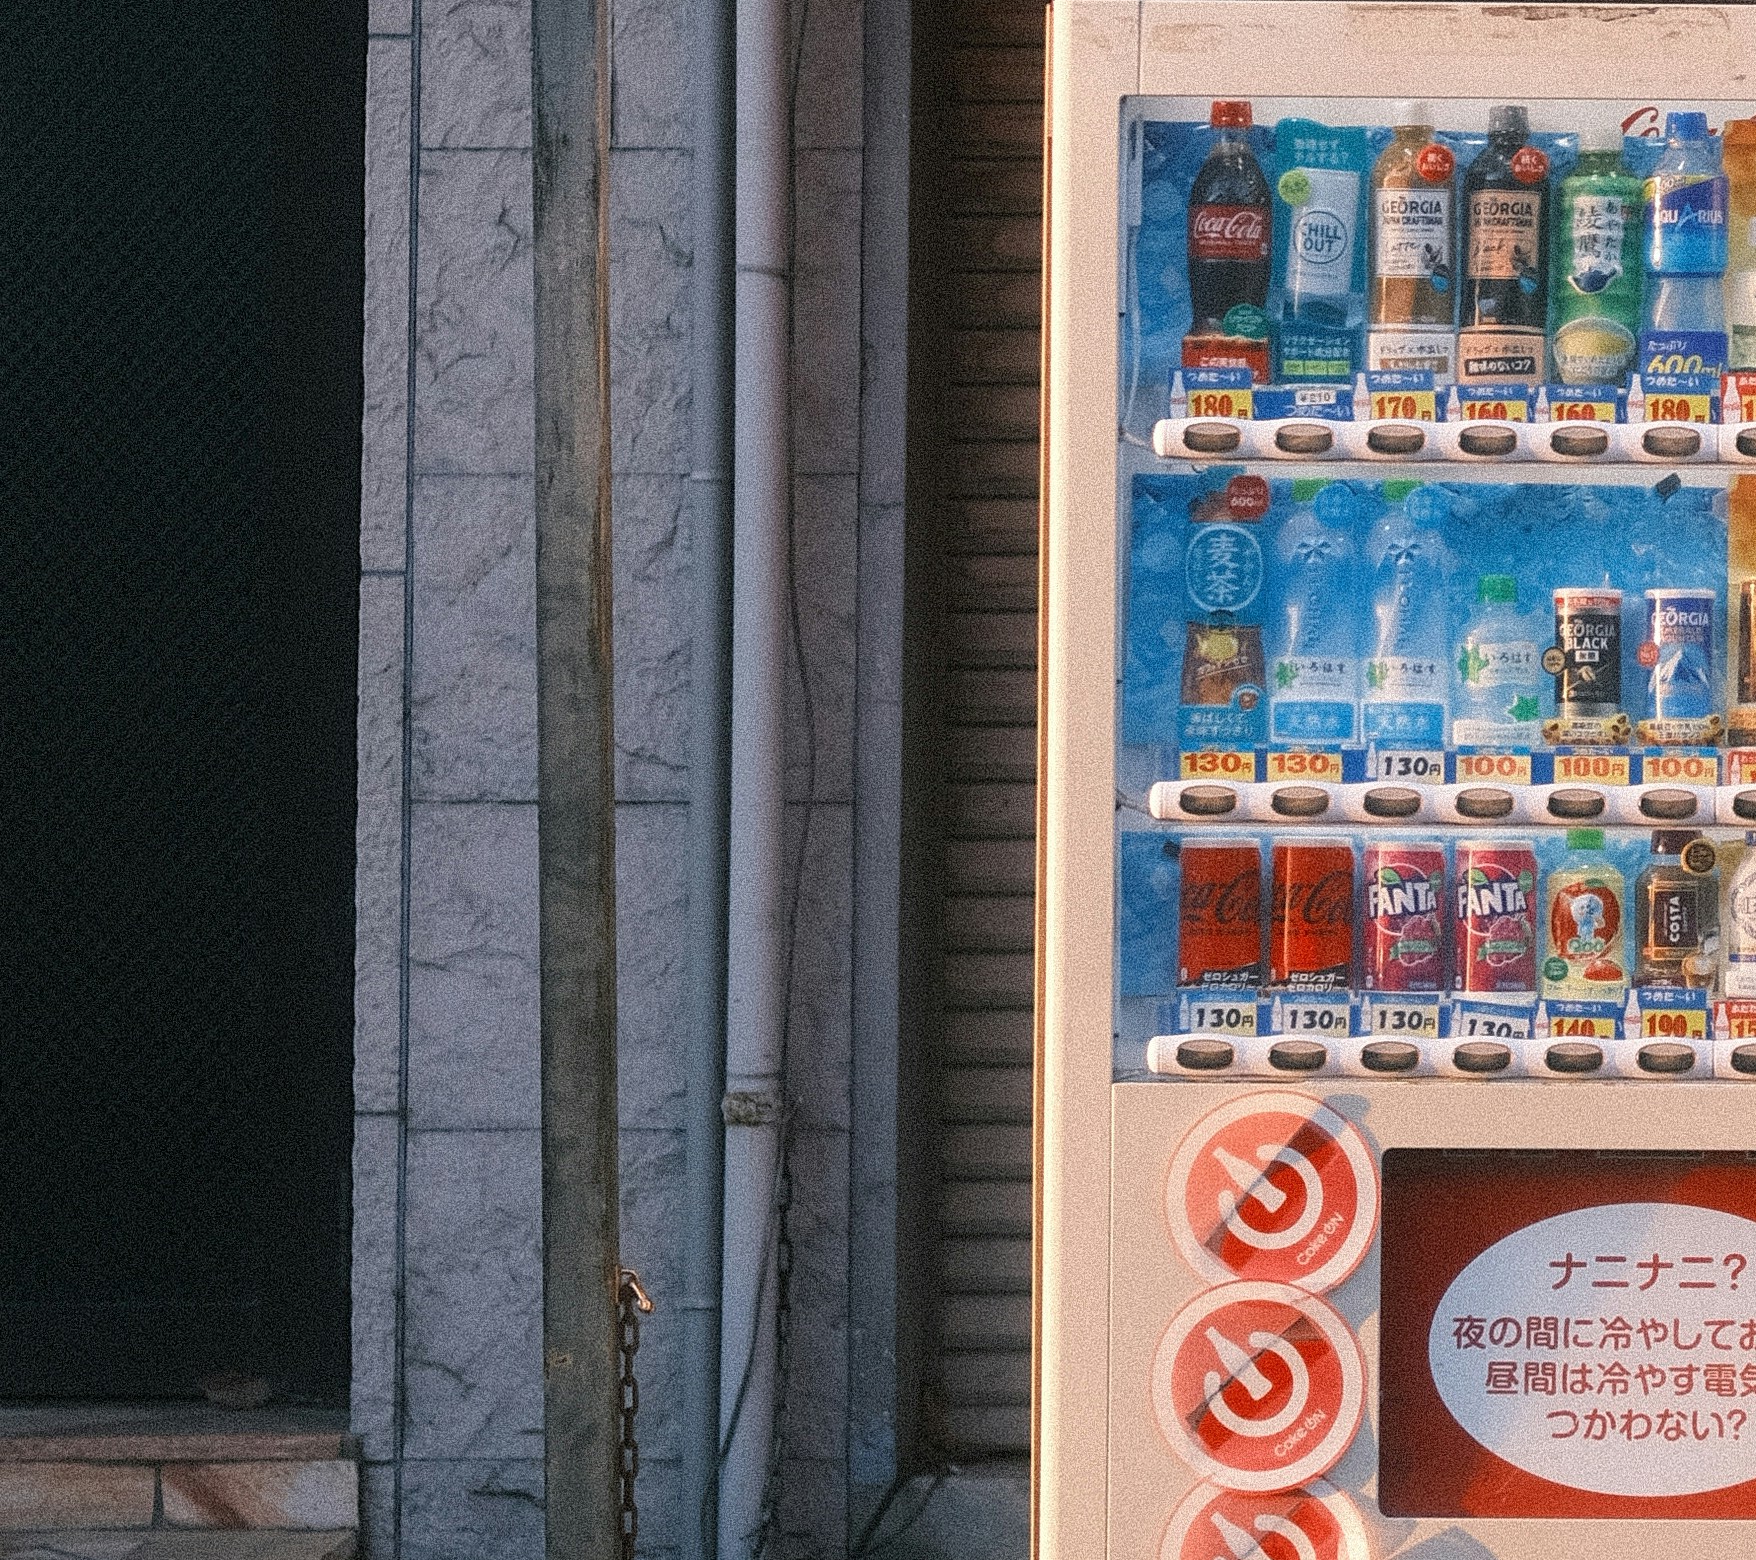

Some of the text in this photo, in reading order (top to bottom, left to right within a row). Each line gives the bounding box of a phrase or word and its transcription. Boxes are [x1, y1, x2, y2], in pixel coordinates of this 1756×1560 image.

[1382, 199, 1443, 215] GEORGIA
[1473, 201, 1533, 216] GEORGIA
[1192, 210, 1263, 240] Coca-Cola
[1301, 224, 1342, 240] CHILL
[1303, 238, 1336, 253] OUT
[1647, 340, 1687, 352] たっぷり
[1203, 533, 1241, 603] 麦茶
[1559, 617, 1617, 636] GEORGIA
[1651, 609, 1710, 627] GEORGIA
[1564, 636, 1609, 651] BLACK
[1184, 752, 1251, 774] 130円
[1270, 753, 1341, 775] 130円
[1383, 756, 1442, 777] 130円
[1459, 756, 1528, 777] 100円
[1558, 755, 1626, 778] 100円
[1647, 757, 1715, 778] 100円
[1367, 881, 1437, 919] FANTA
[1457, 882, 1528, 920] FANTA
[1669, 894, 1681, 943] COSTA
[1202, 971, 1259, 981] ゼロシュガー
[1290, 972, 1346, 982] ゼロシュガー
[1195, 1008, 1254, 1029] 130円
[1289, 1010, 1347, 1030] 130円
[1377, 1010, 1436, 1030] 130円
[1296, 1231, 1328, 1266] Coke
[1549, 1253, 1747, 1291] ナニナニ?
[1547, 1408, 1747, 1442] つかわない?
[1274, 1424, 1308, 1458] Coke
